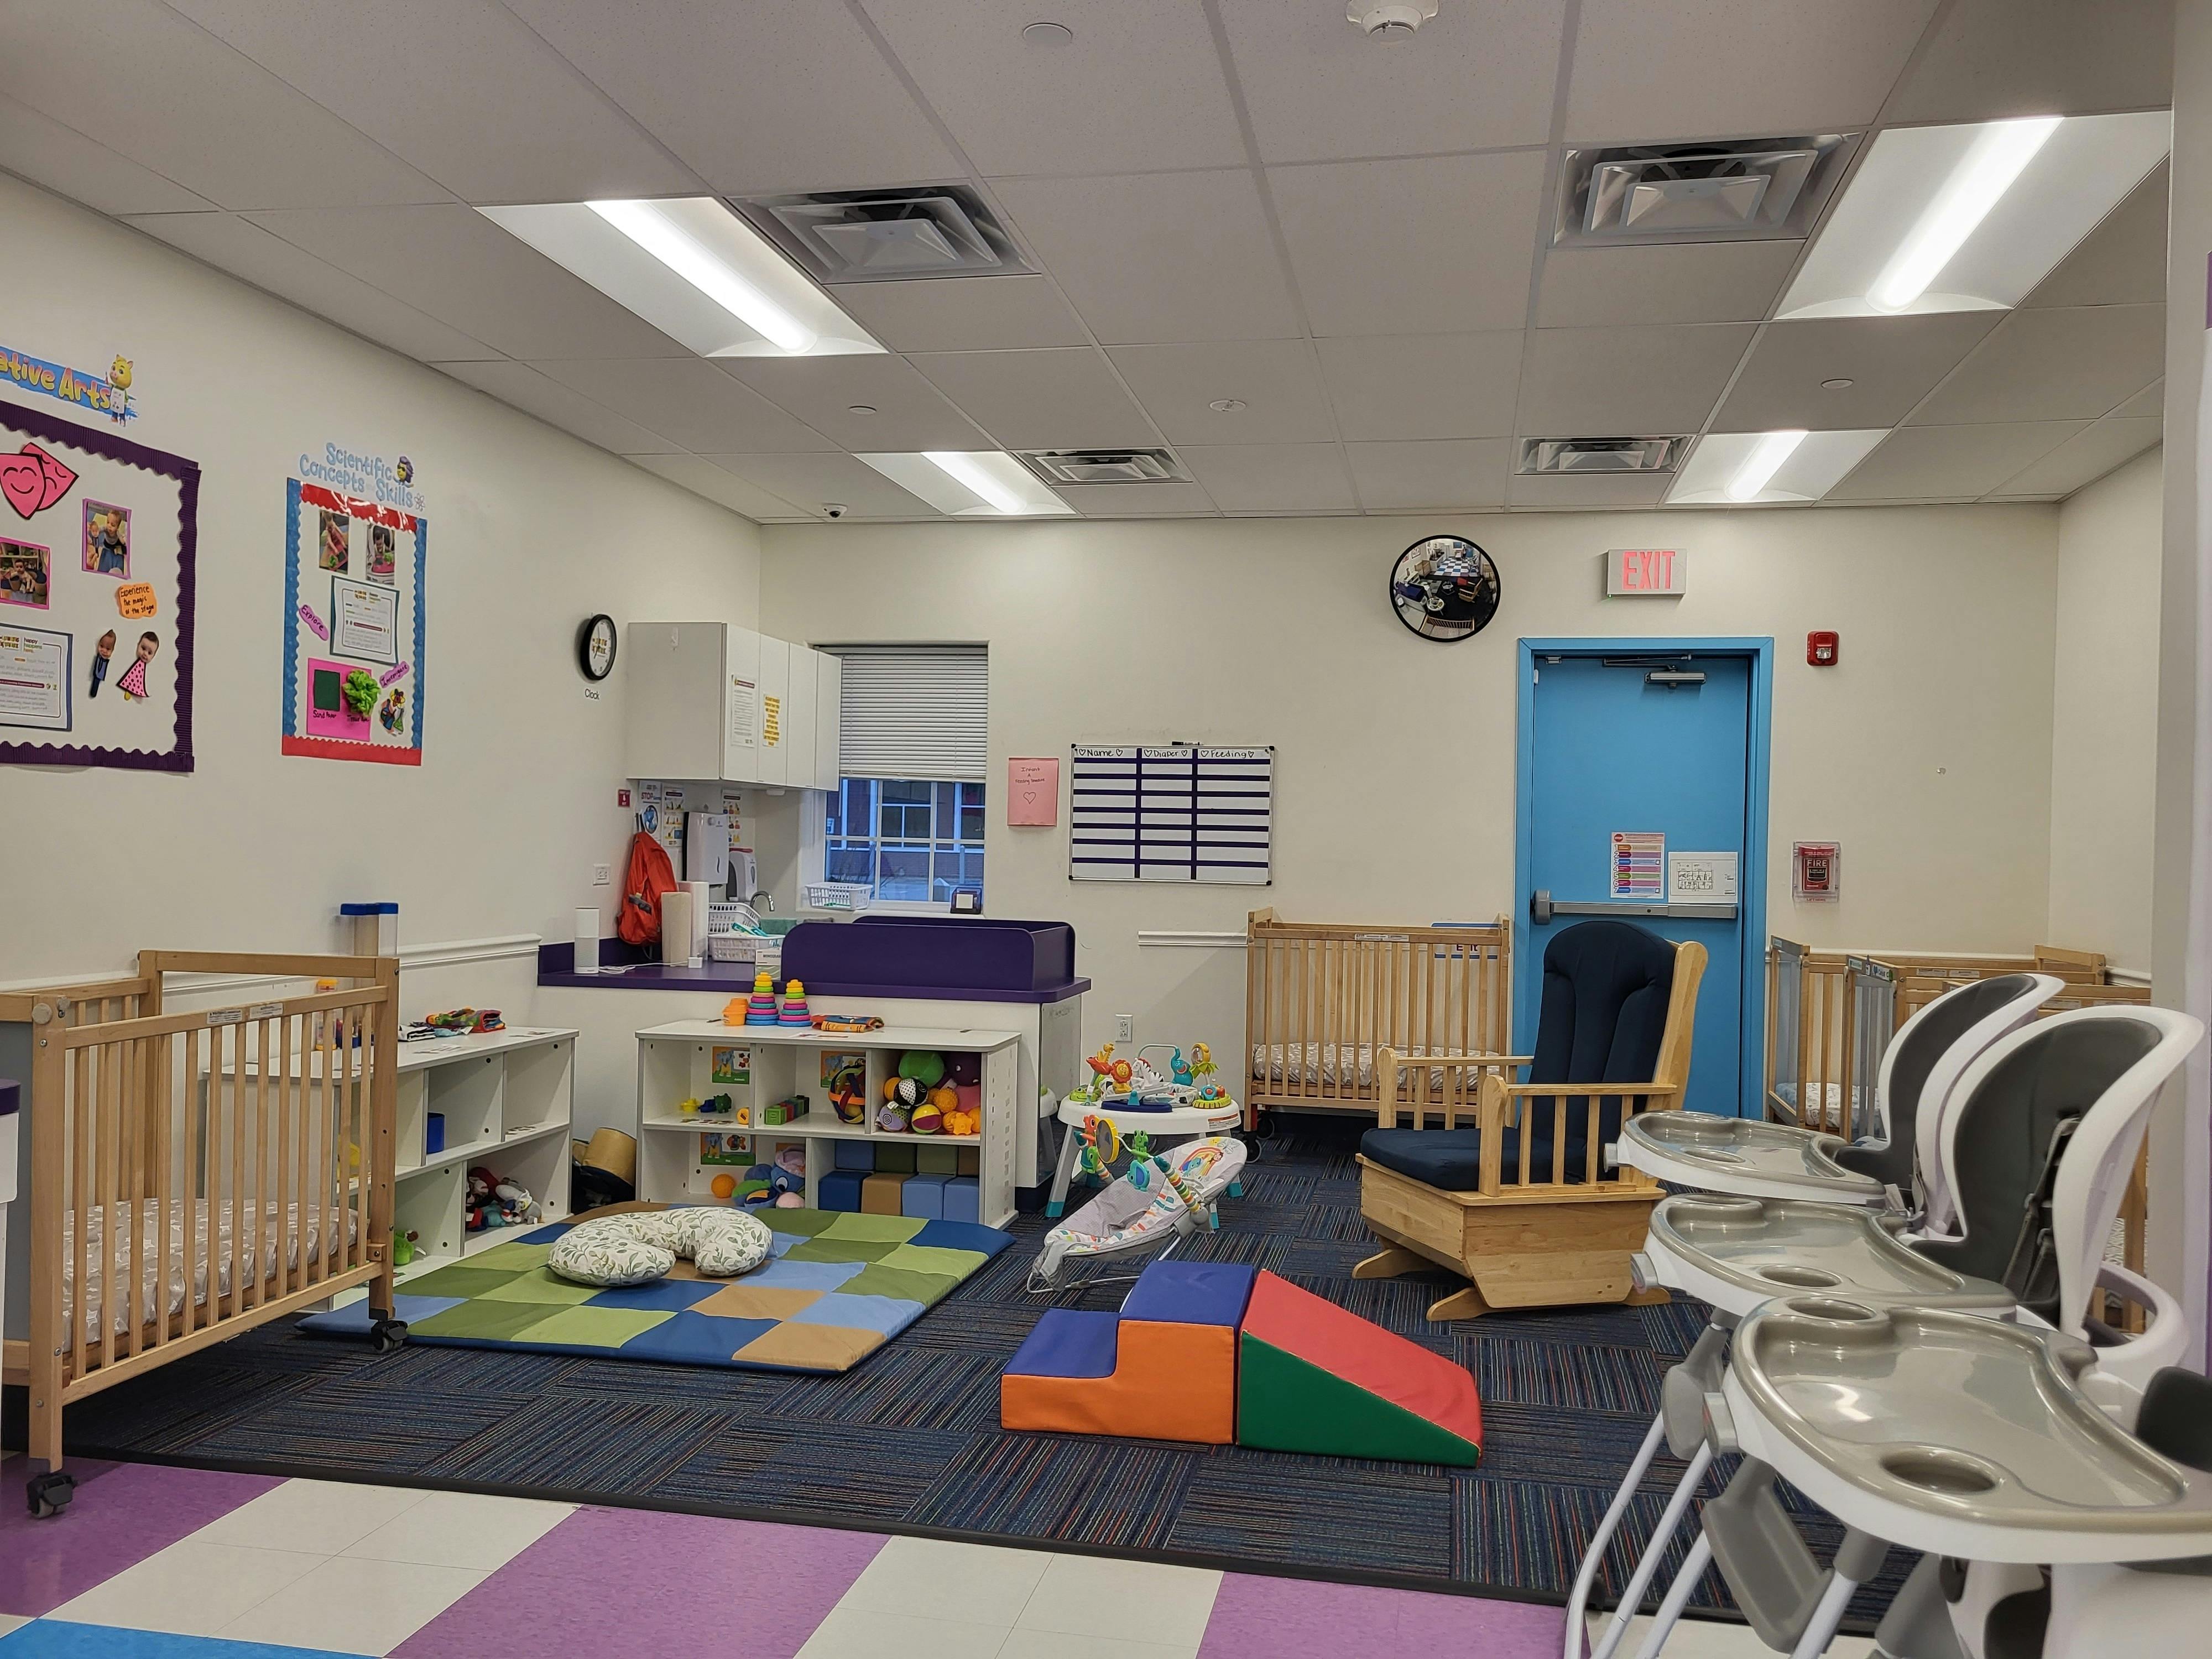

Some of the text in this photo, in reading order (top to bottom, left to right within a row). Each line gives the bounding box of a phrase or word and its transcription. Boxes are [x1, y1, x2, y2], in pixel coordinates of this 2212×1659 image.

[59, 367, 110, 409] Arts
[326, 442, 392, 481] Scientific
[299, 453, 414, 508] Concepts Skills
[1623, 551, 1675, 589] EXIT
[121, 585, 150, 598] Experience
[133, 595, 147, 606] magic
[301, 604, 324, 631] Explore
[585, 688, 599, 700] Clock
[313, 709, 325, 718] Sand
[1153, 750, 1179, 759] Diaper
[1211, 750, 1247, 759] Feeding
[641, 792, 653, 800] STOP
